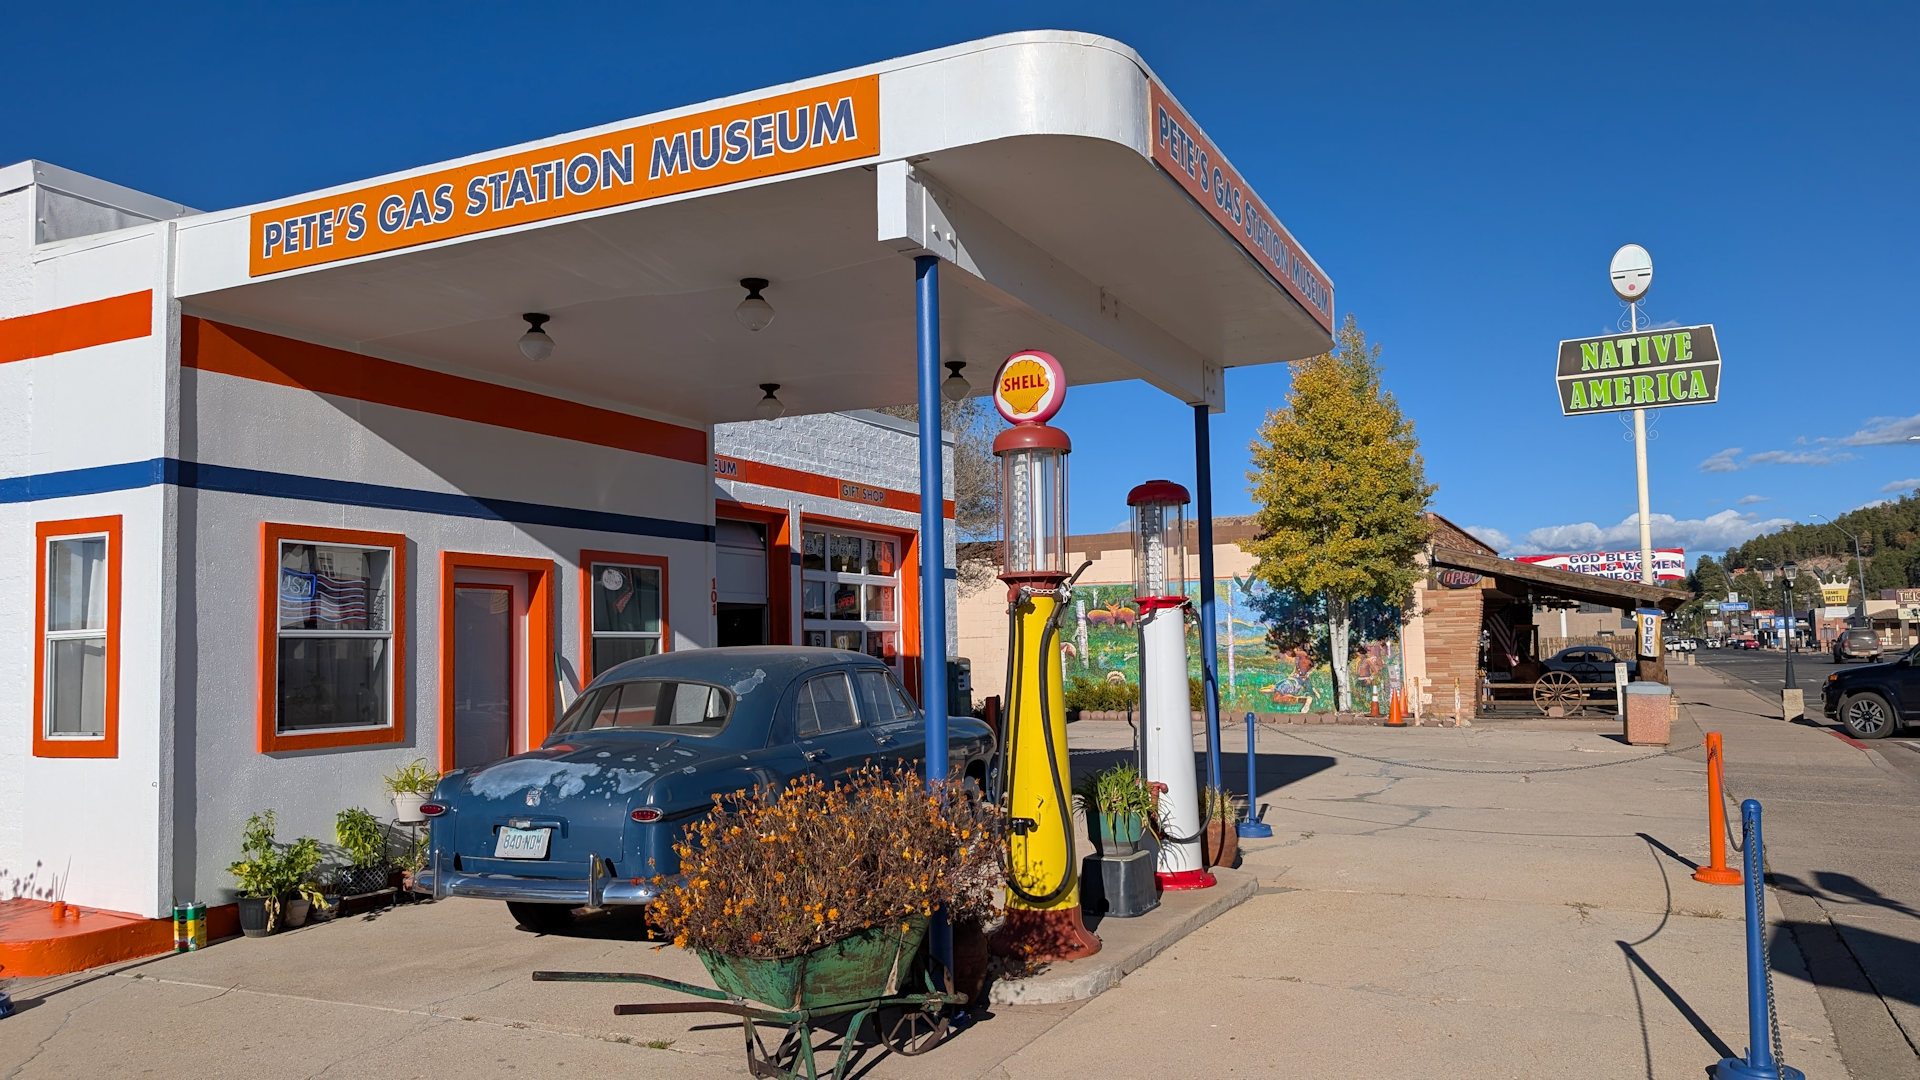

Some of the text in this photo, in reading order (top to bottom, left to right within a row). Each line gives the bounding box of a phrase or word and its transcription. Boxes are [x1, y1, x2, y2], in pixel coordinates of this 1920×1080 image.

[263, 96, 858, 258] PETE'S GAS STATION MUSEUM
[1158, 103, 1330, 319] PETE'S GAS STATION MUSEUM
[1580, 332, 1693, 371] NATIVE
[1004, 374, 1045, 392] SHELL
[1569, 369, 1709, 410] AMERICA
[842, 484, 884, 501] GIFT SHOP
[1568, 563, 1600, 573] MEN
[1606, 562, 1617, 572] &
[1569, 552, 1600, 564] GOD
[280, 574, 312, 595] USA
[1444, 570, 1477, 585] OPEN
[1644, 616, 1654, 654] OPEN
